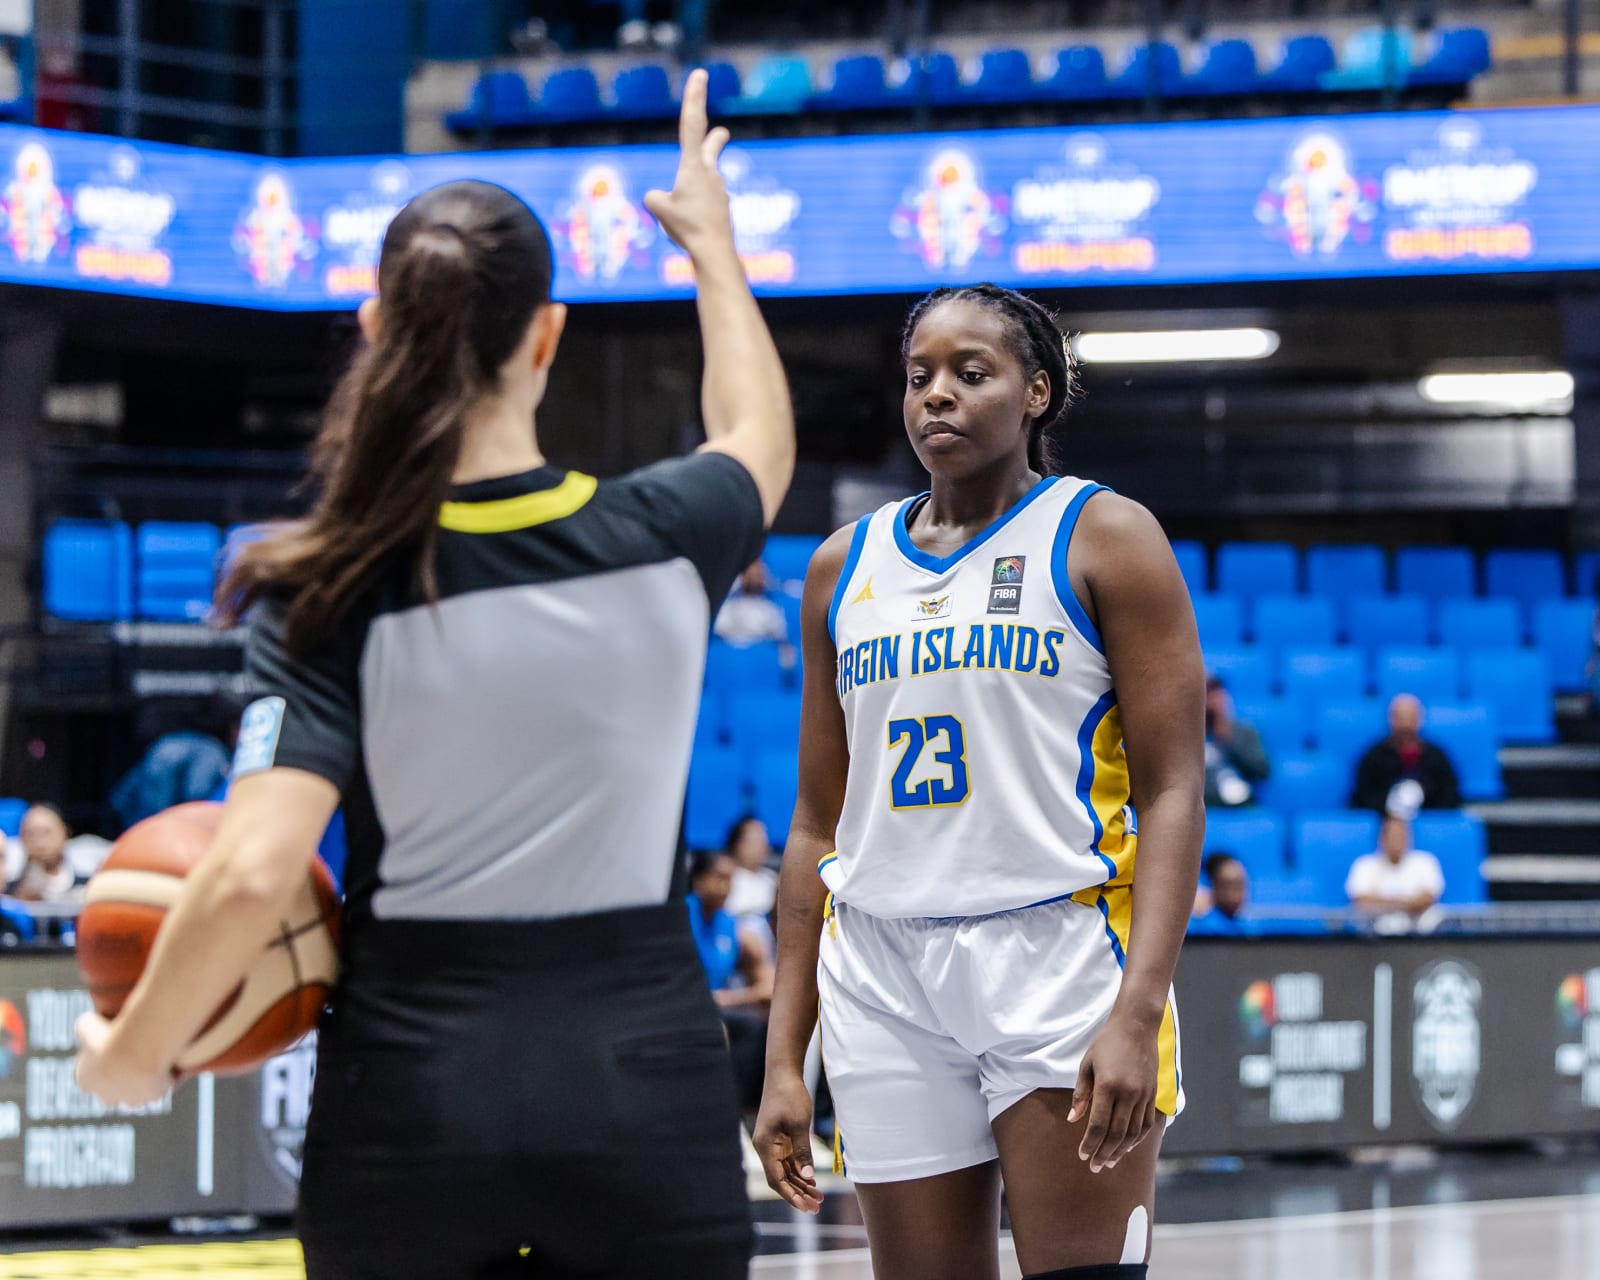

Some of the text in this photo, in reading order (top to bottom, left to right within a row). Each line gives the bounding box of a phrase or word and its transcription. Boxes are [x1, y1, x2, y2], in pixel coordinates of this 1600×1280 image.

[993, 588, 1017, 599] FIBA
[838, 624, 1065, 698] IRGIN ISLANDS
[887, 714, 972, 810] 23
